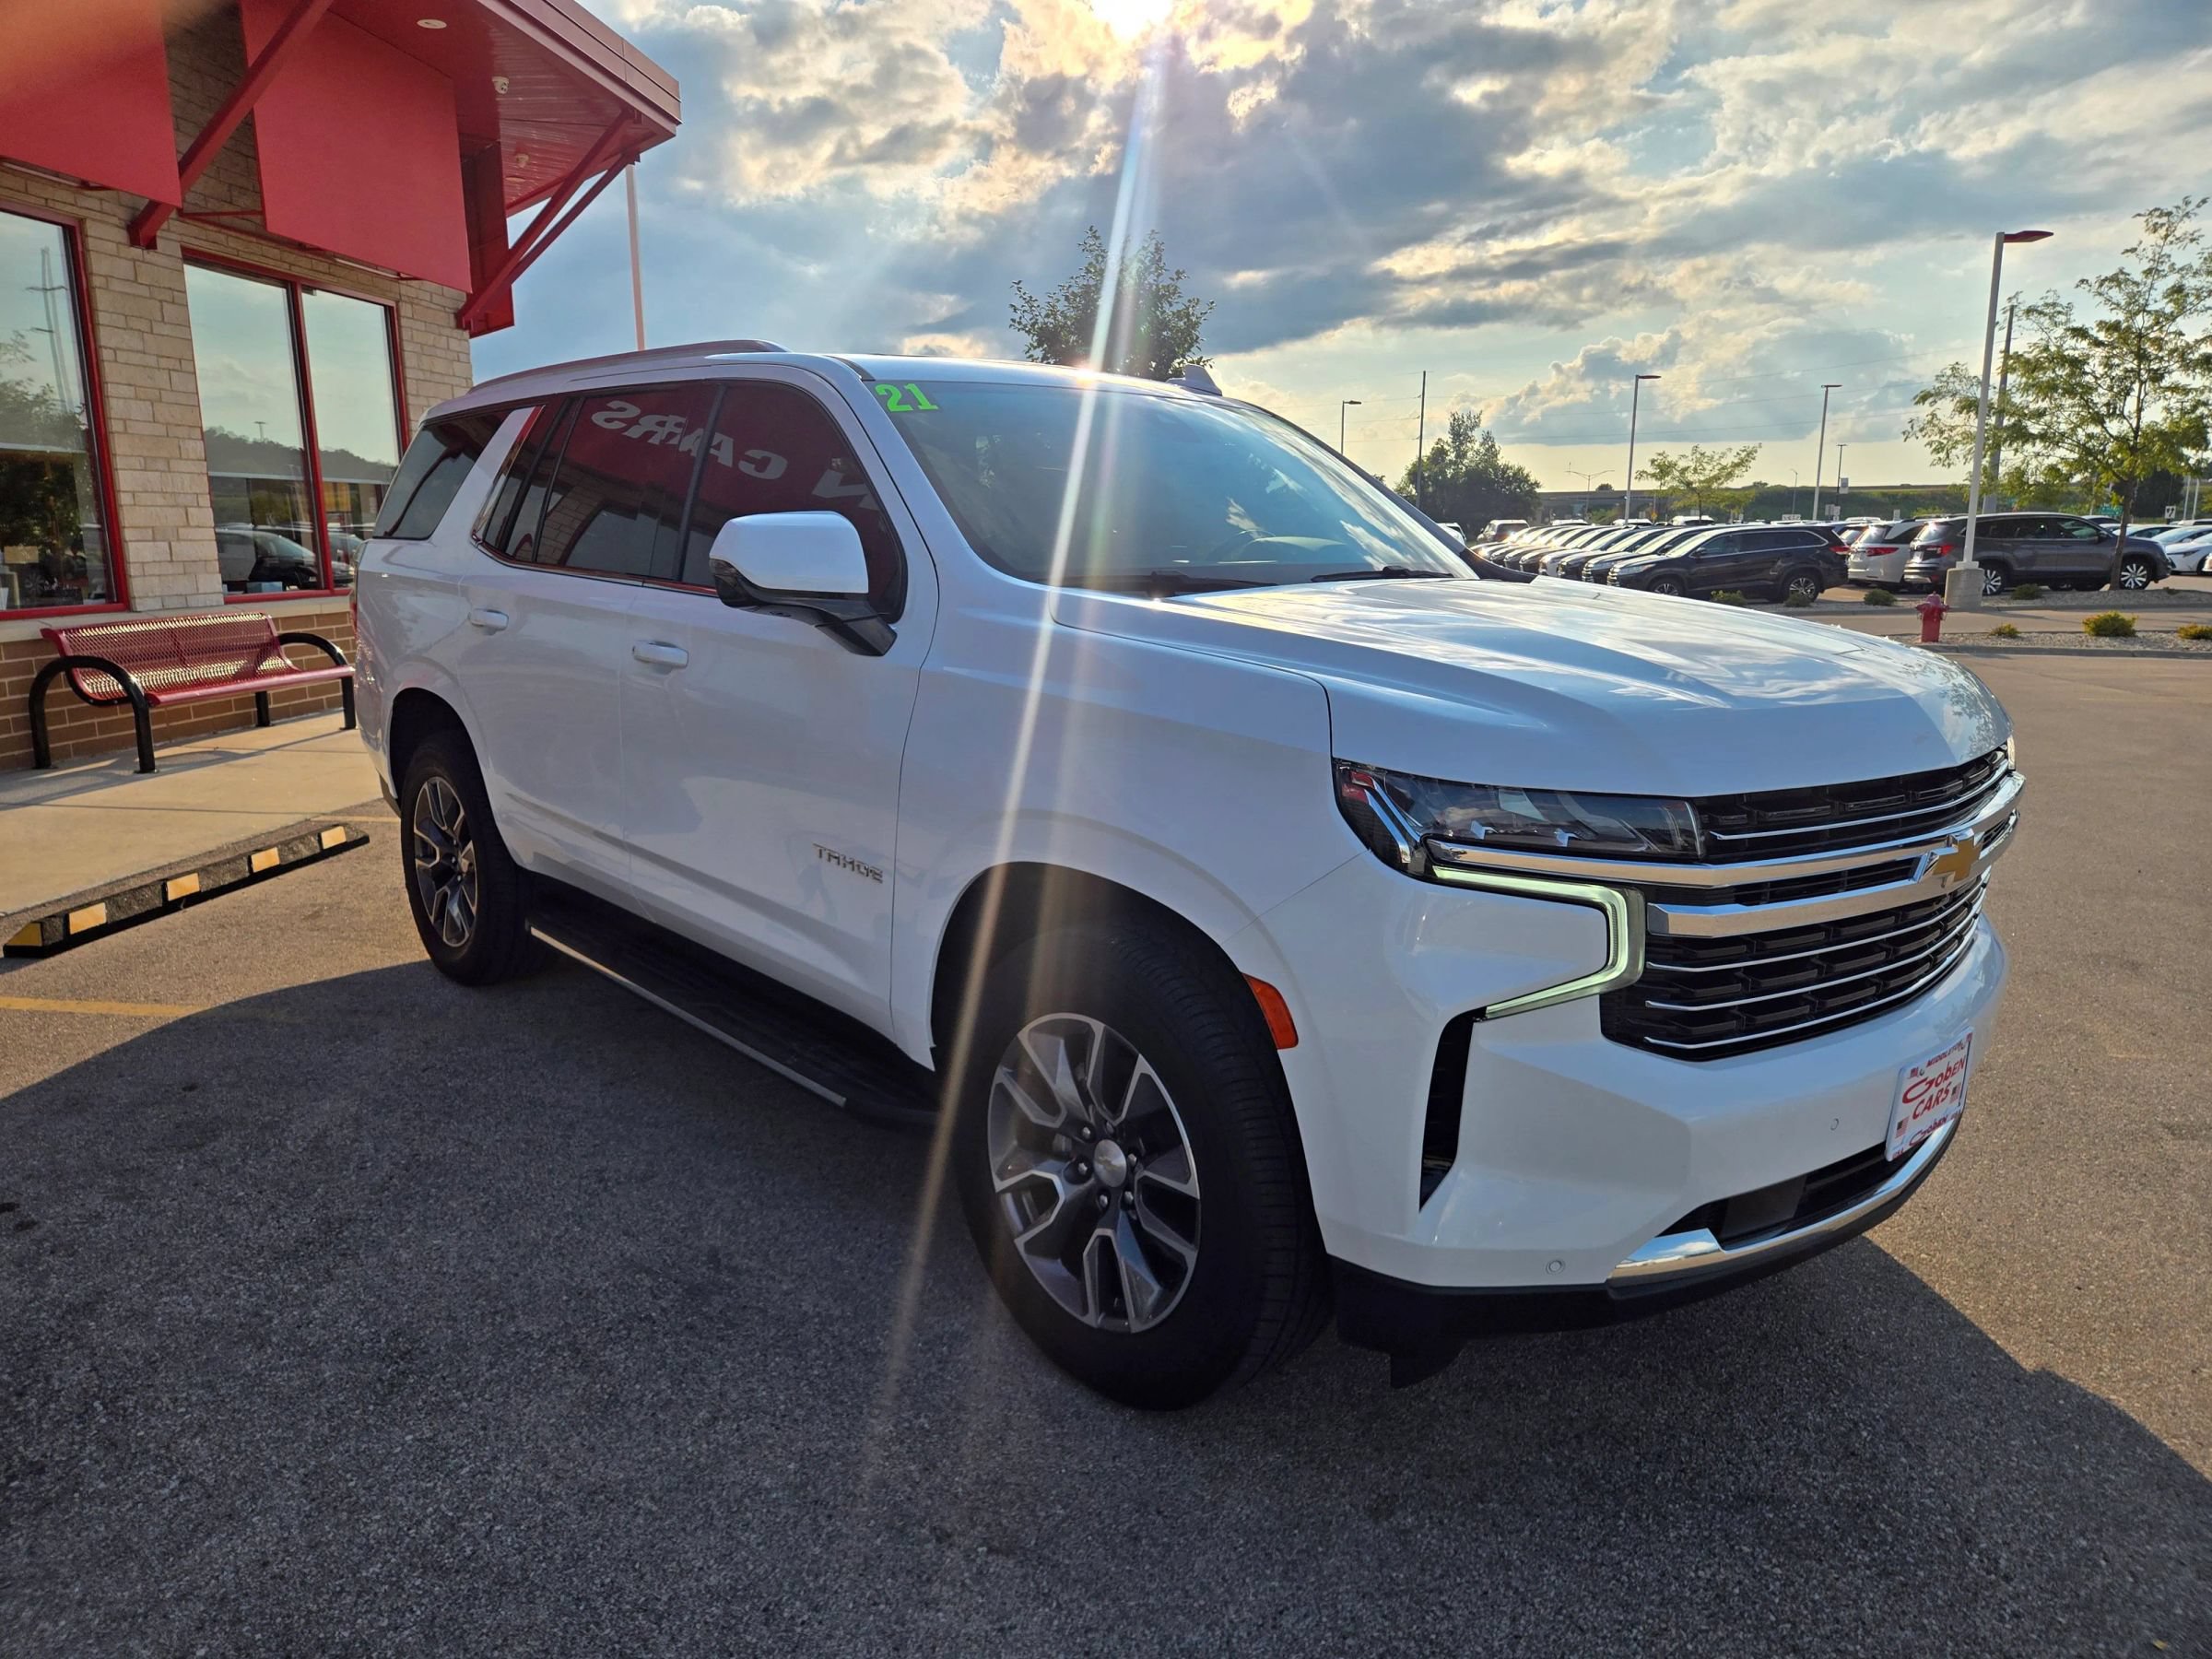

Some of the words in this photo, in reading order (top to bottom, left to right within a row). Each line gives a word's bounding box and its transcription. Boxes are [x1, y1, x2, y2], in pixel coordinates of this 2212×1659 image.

[876, 383, 938, 412] 21
[813, 842, 883, 884] TAHOE
[1912, 1081, 1952, 1120] CARS
